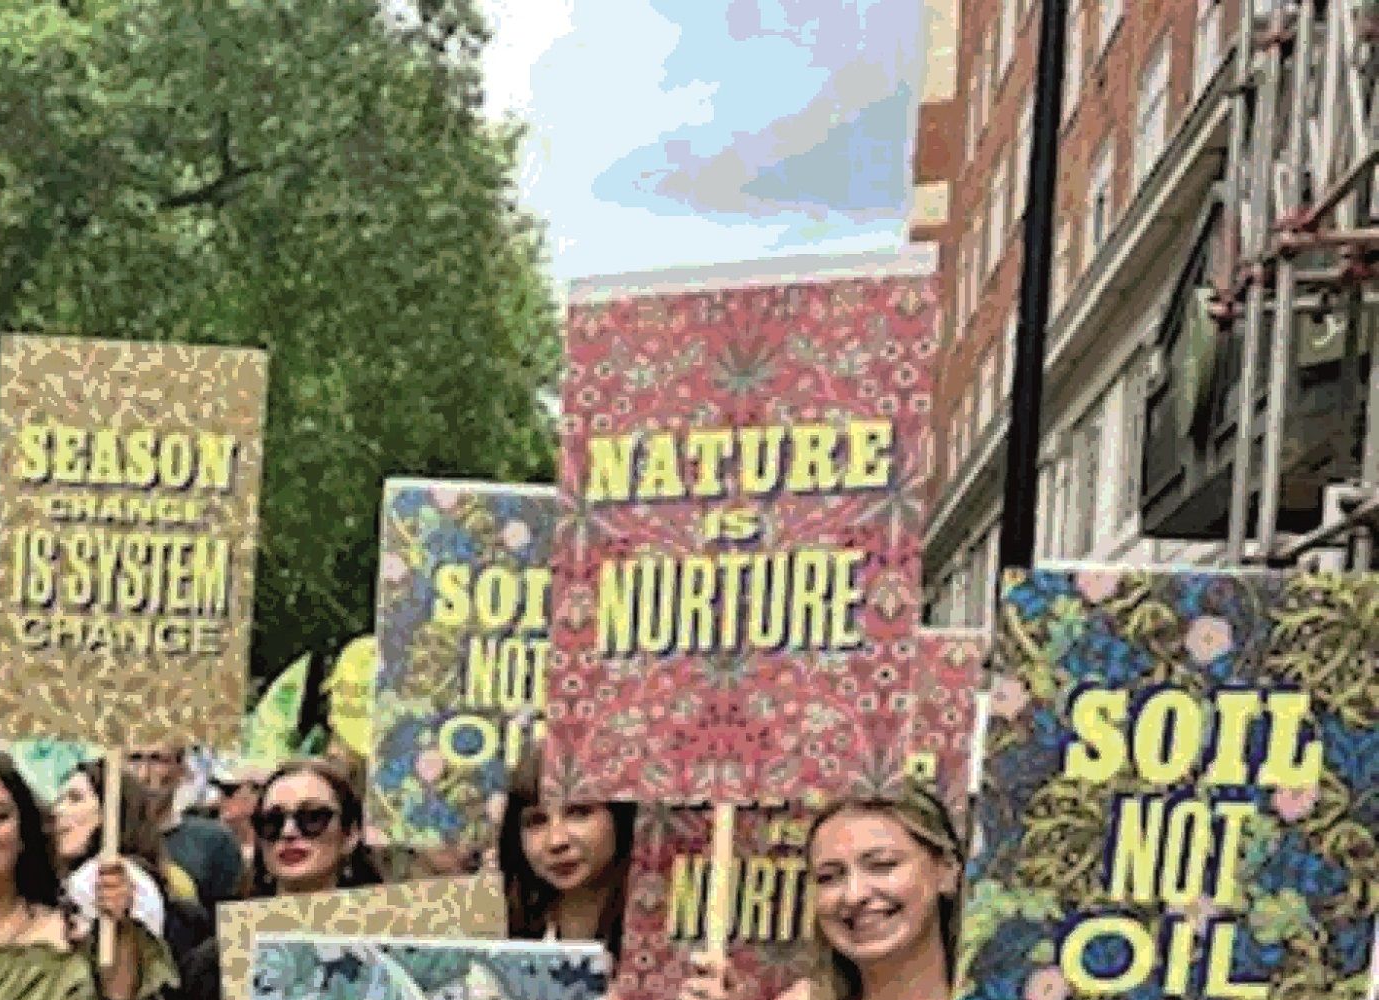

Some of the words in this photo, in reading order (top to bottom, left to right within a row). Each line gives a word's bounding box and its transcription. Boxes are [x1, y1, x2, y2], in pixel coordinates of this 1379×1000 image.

[18, 424, 237, 490] SEASON
[587, 419, 893, 501] NATURE
[51, 498, 204, 524] CHANGE
[704, 508, 761, 541] IS
[15, 527, 54, 607] IS
[66, 533, 230, 616] SYSTEM
[433, 563, 553, 628] SOI
[598, 549, 867, 655] NURTURE
[18, 616, 224, 655] CHANGE
[438, 712, 547, 767] OI
[1063, 689, 1324, 788] SOIL
[1110, 798, 1259, 905] NOT
[1059, 916, 1271, 1000] OIL
